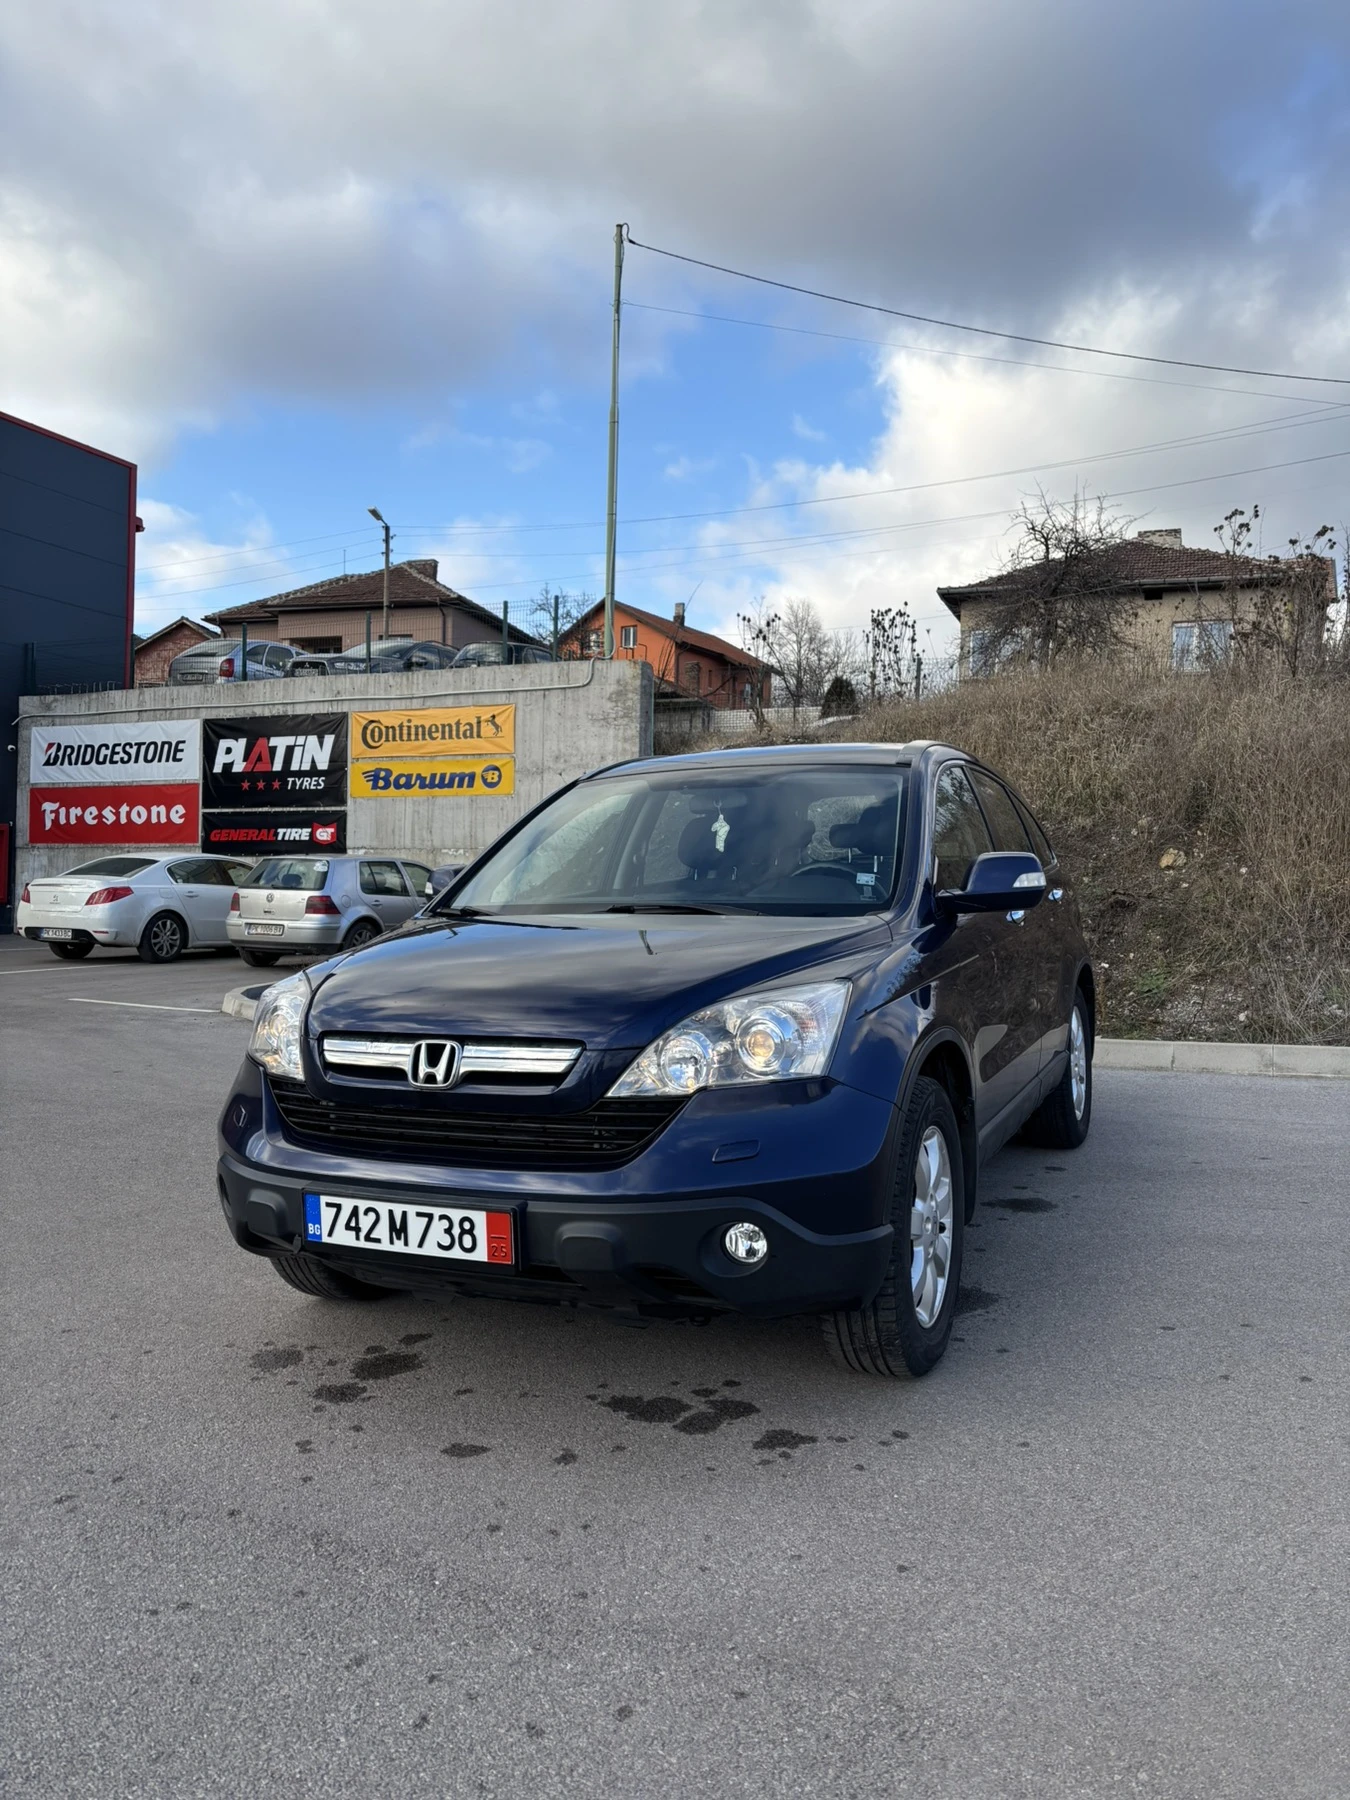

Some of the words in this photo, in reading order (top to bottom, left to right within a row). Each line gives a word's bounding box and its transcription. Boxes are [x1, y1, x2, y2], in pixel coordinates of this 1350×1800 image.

[361, 715, 483, 749] Continental
[42, 740, 186, 766] BRIDGESTONE
[287, 777, 326, 790] TYRES
[362, 767, 476, 791] Barum
[41, 801, 186, 831] Firestone
[307, 1223, 321, 1236] BG
[491, 1244, 508, 1258] 25
